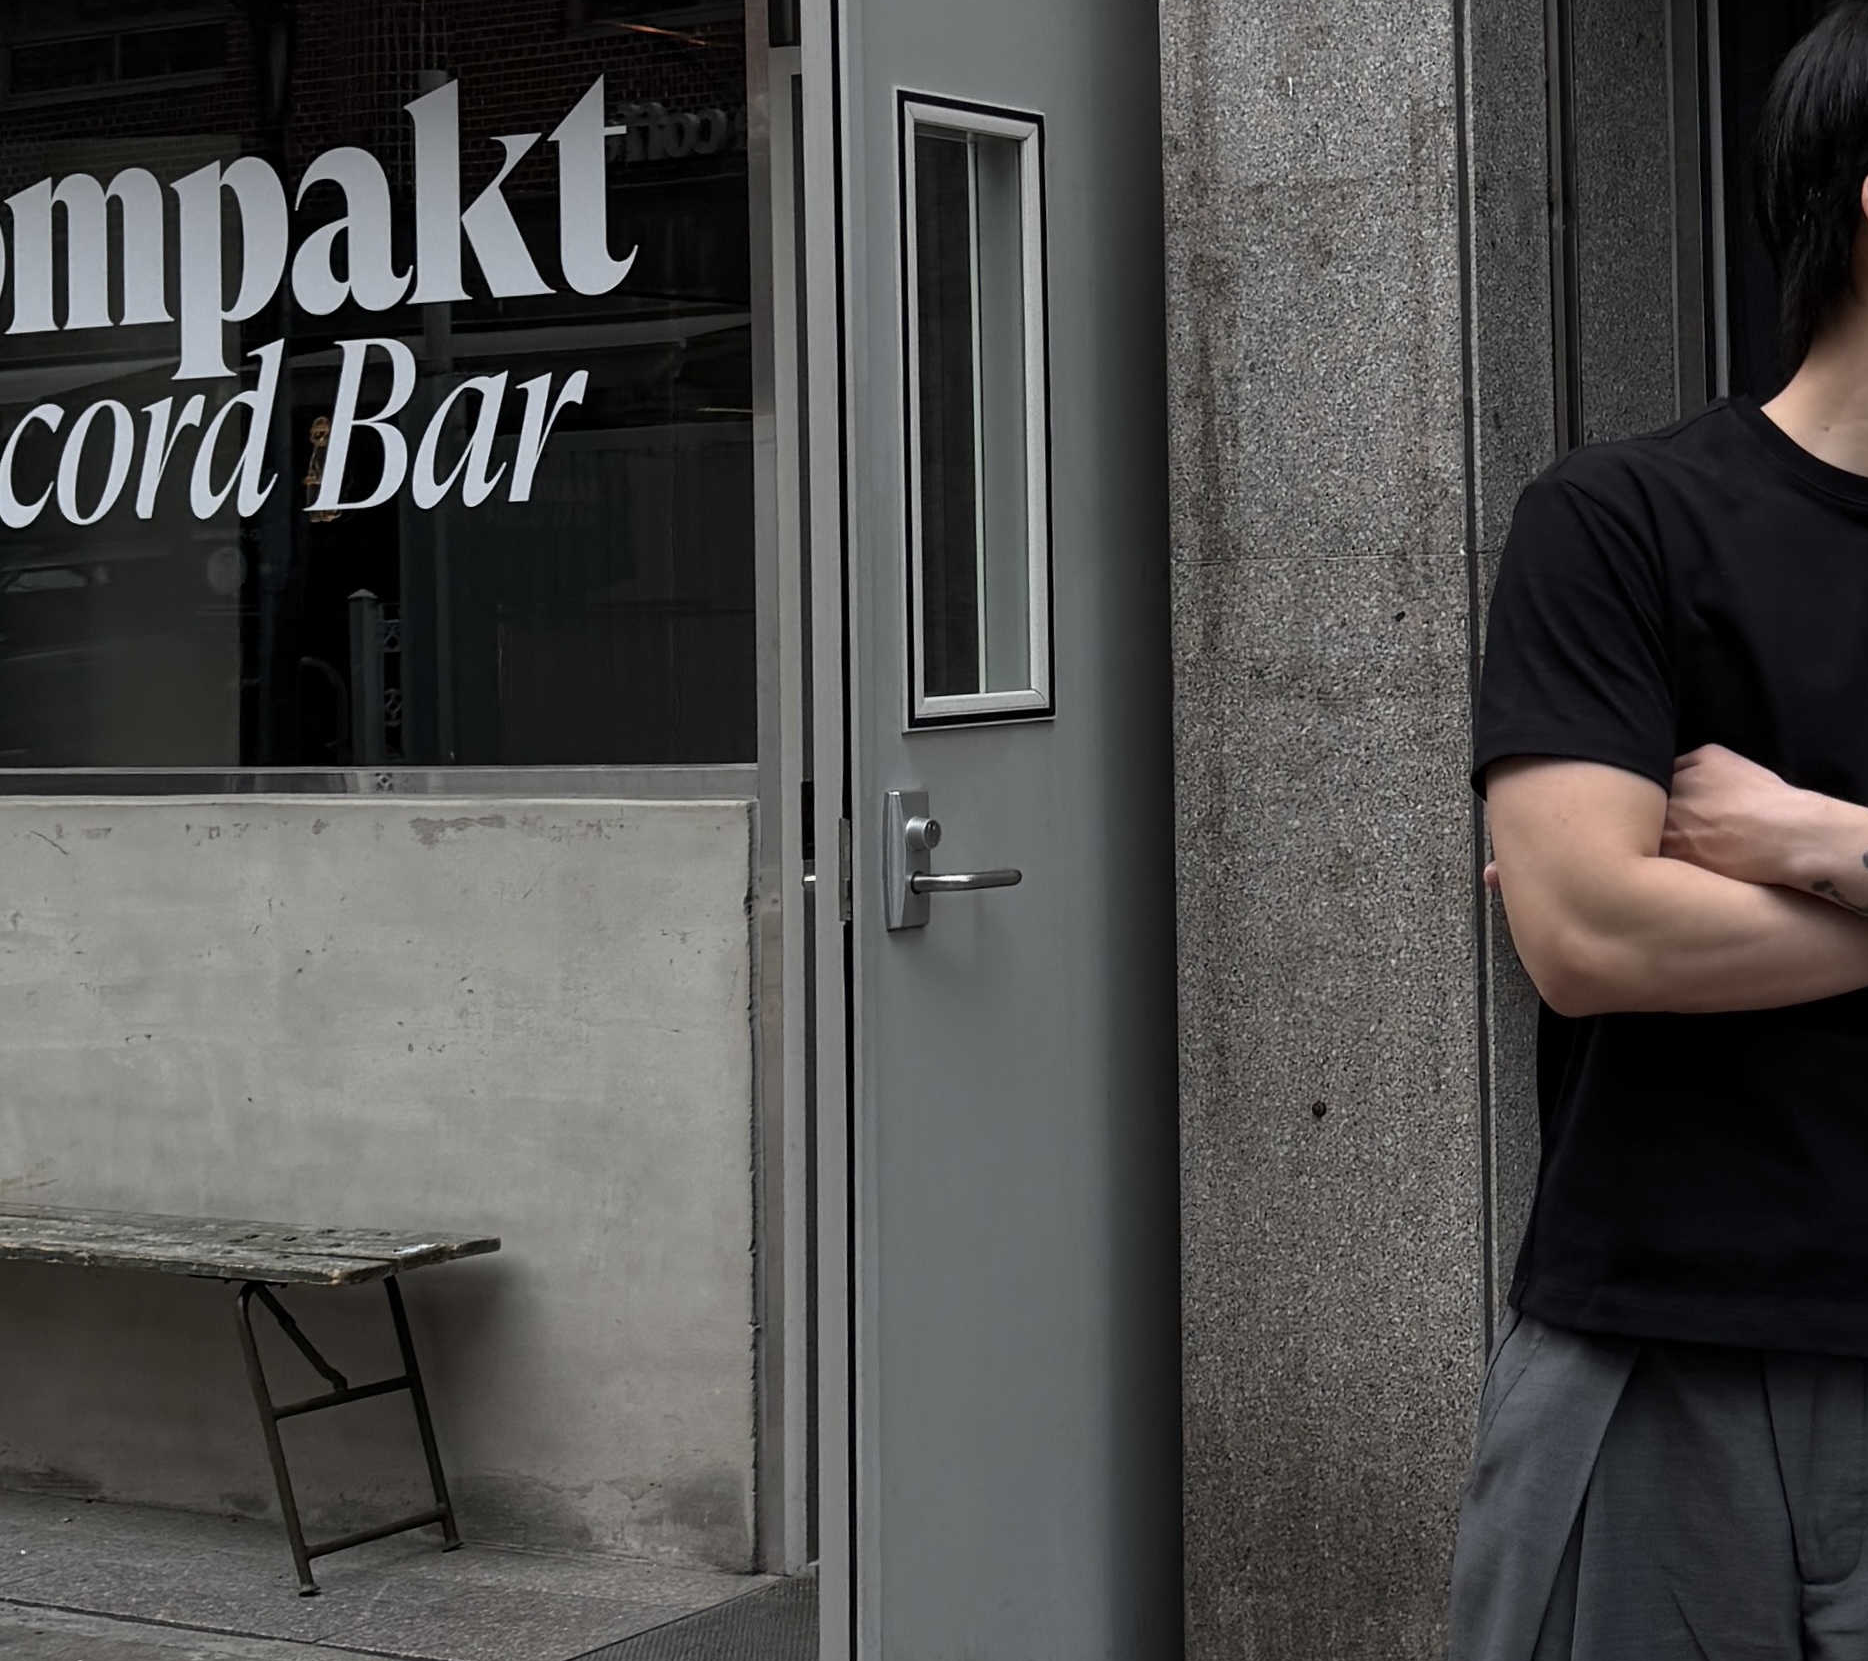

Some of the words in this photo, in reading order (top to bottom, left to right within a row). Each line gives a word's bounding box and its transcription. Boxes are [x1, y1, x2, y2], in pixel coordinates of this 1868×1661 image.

[0, 72, 639, 381] mpakt
[0, 338, 286, 529] cord
[303, 337, 589, 512] Bar
